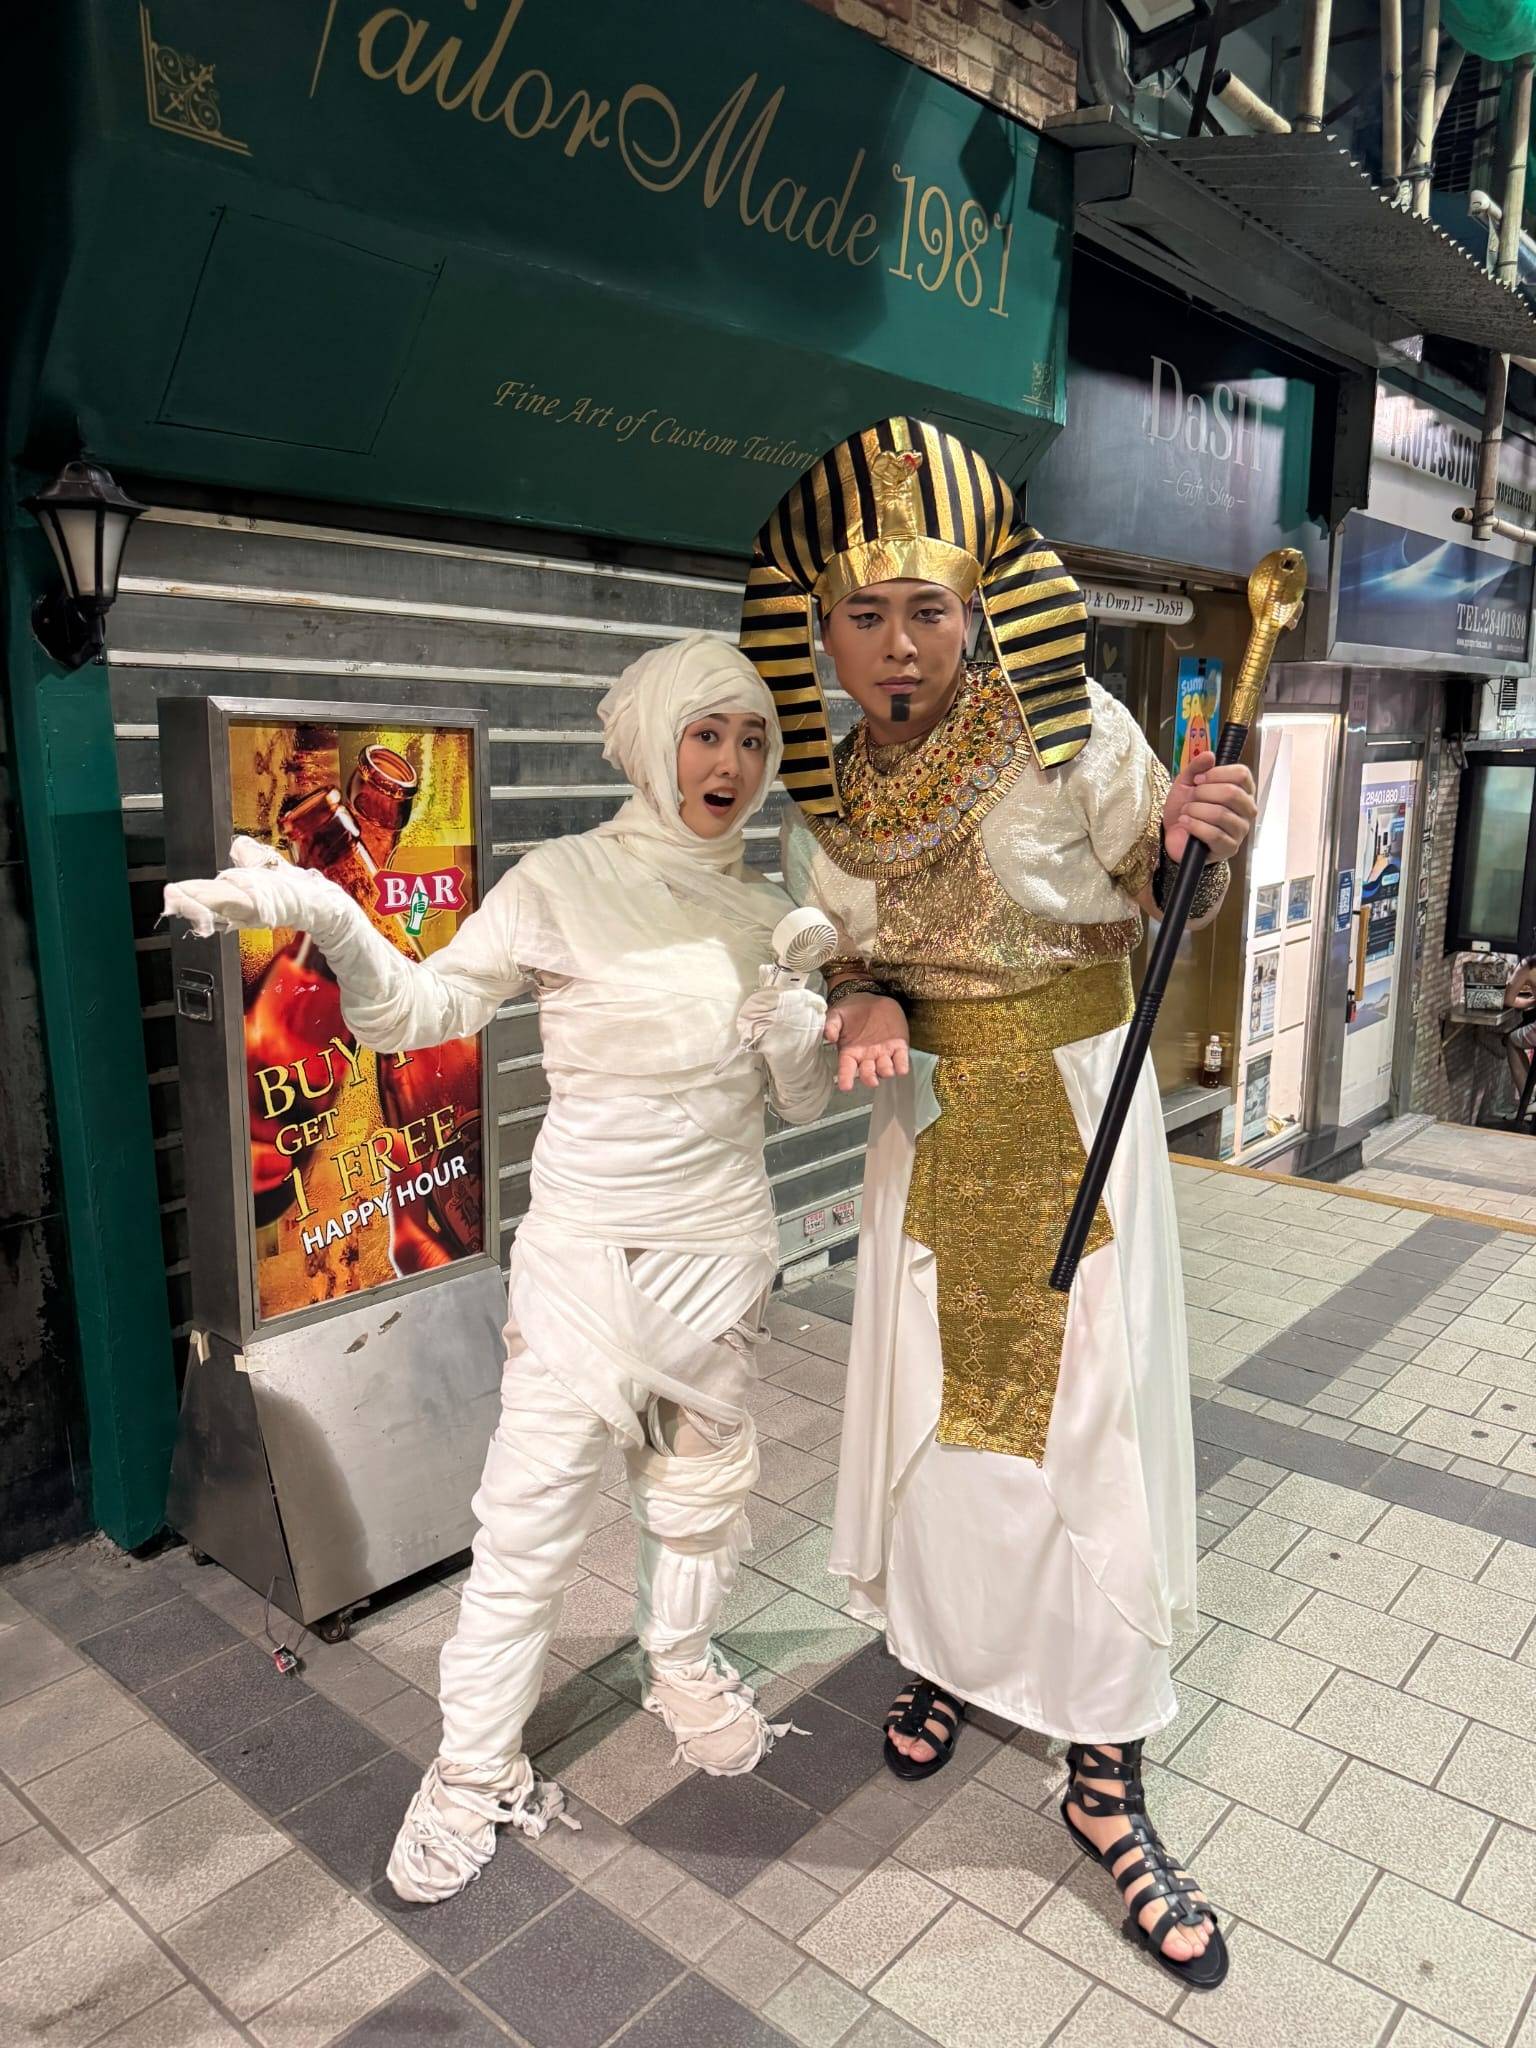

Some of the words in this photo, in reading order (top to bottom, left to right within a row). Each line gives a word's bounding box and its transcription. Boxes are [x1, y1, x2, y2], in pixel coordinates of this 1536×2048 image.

[308, 0, 611, 158] ailor
[888, 163, 1011, 318] 1981
[494, 381, 561, 416] Fine
[555, 398, 614, 428] Art
[615, 409, 658, 443] of
[650, 417, 738, 456] Custom
[1148, 355, 1264, 472] DaSH
[1155, 598, 1184, 616] DaSH
[383, 875, 459, 908] BAR
[254, 1036, 367, 1119] BUY
[275, 1107, 339, 1156] GET
[282, 1167, 318, 1222] 1
[331, 1104, 462, 1200] FREE
[301, 1190, 391, 1255] HAPPY
[396, 1155, 468, 1207] HOUR
